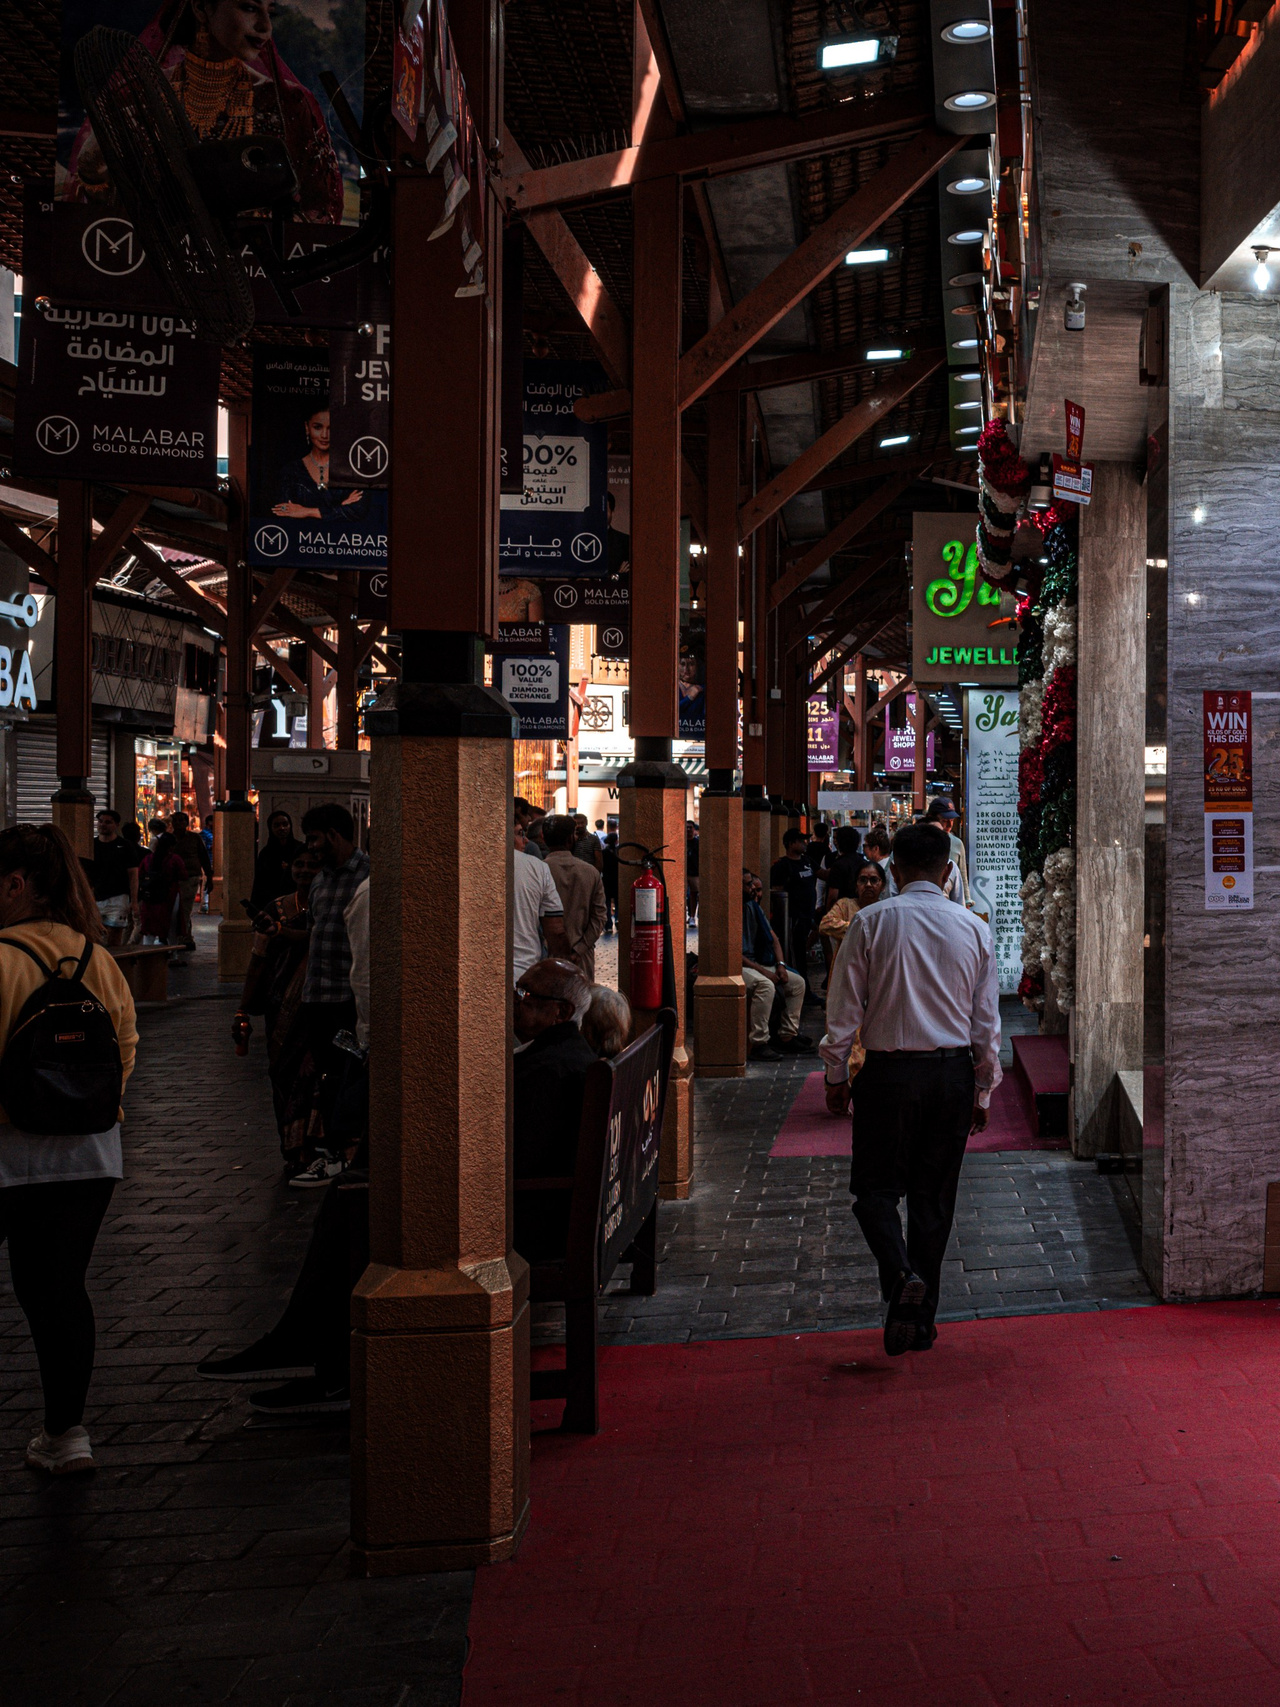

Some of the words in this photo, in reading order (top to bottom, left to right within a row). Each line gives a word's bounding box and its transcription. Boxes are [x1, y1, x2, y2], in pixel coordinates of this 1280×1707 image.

[66, 335, 175, 367] المضافة
[299, 377, 321, 387] IT'S
[267, 385, 287, 394] YOU
[289, 386, 320, 396] INVEST
[526, 383, 562, 398] الوقت
[93, 424, 205, 448] MALABAR
[92, 443, 128, 454] GOLD
[129, 445, 138, 455] &
[140, 446, 205, 460] DIAMONDS
[299, 530, 388, 548] MALABAR
[299, 545, 326, 555] GOLD
[328, 546, 335, 555] &
[336, 547, 388, 558] DIAMONDS
[510, 664, 553, 677] 100%
[1207, 711, 1247, 730] WIN
[1207, 735, 1227, 743] THIS
[1228, 735, 1248, 743] DSF!
[1211, 747, 1245, 775] 25
